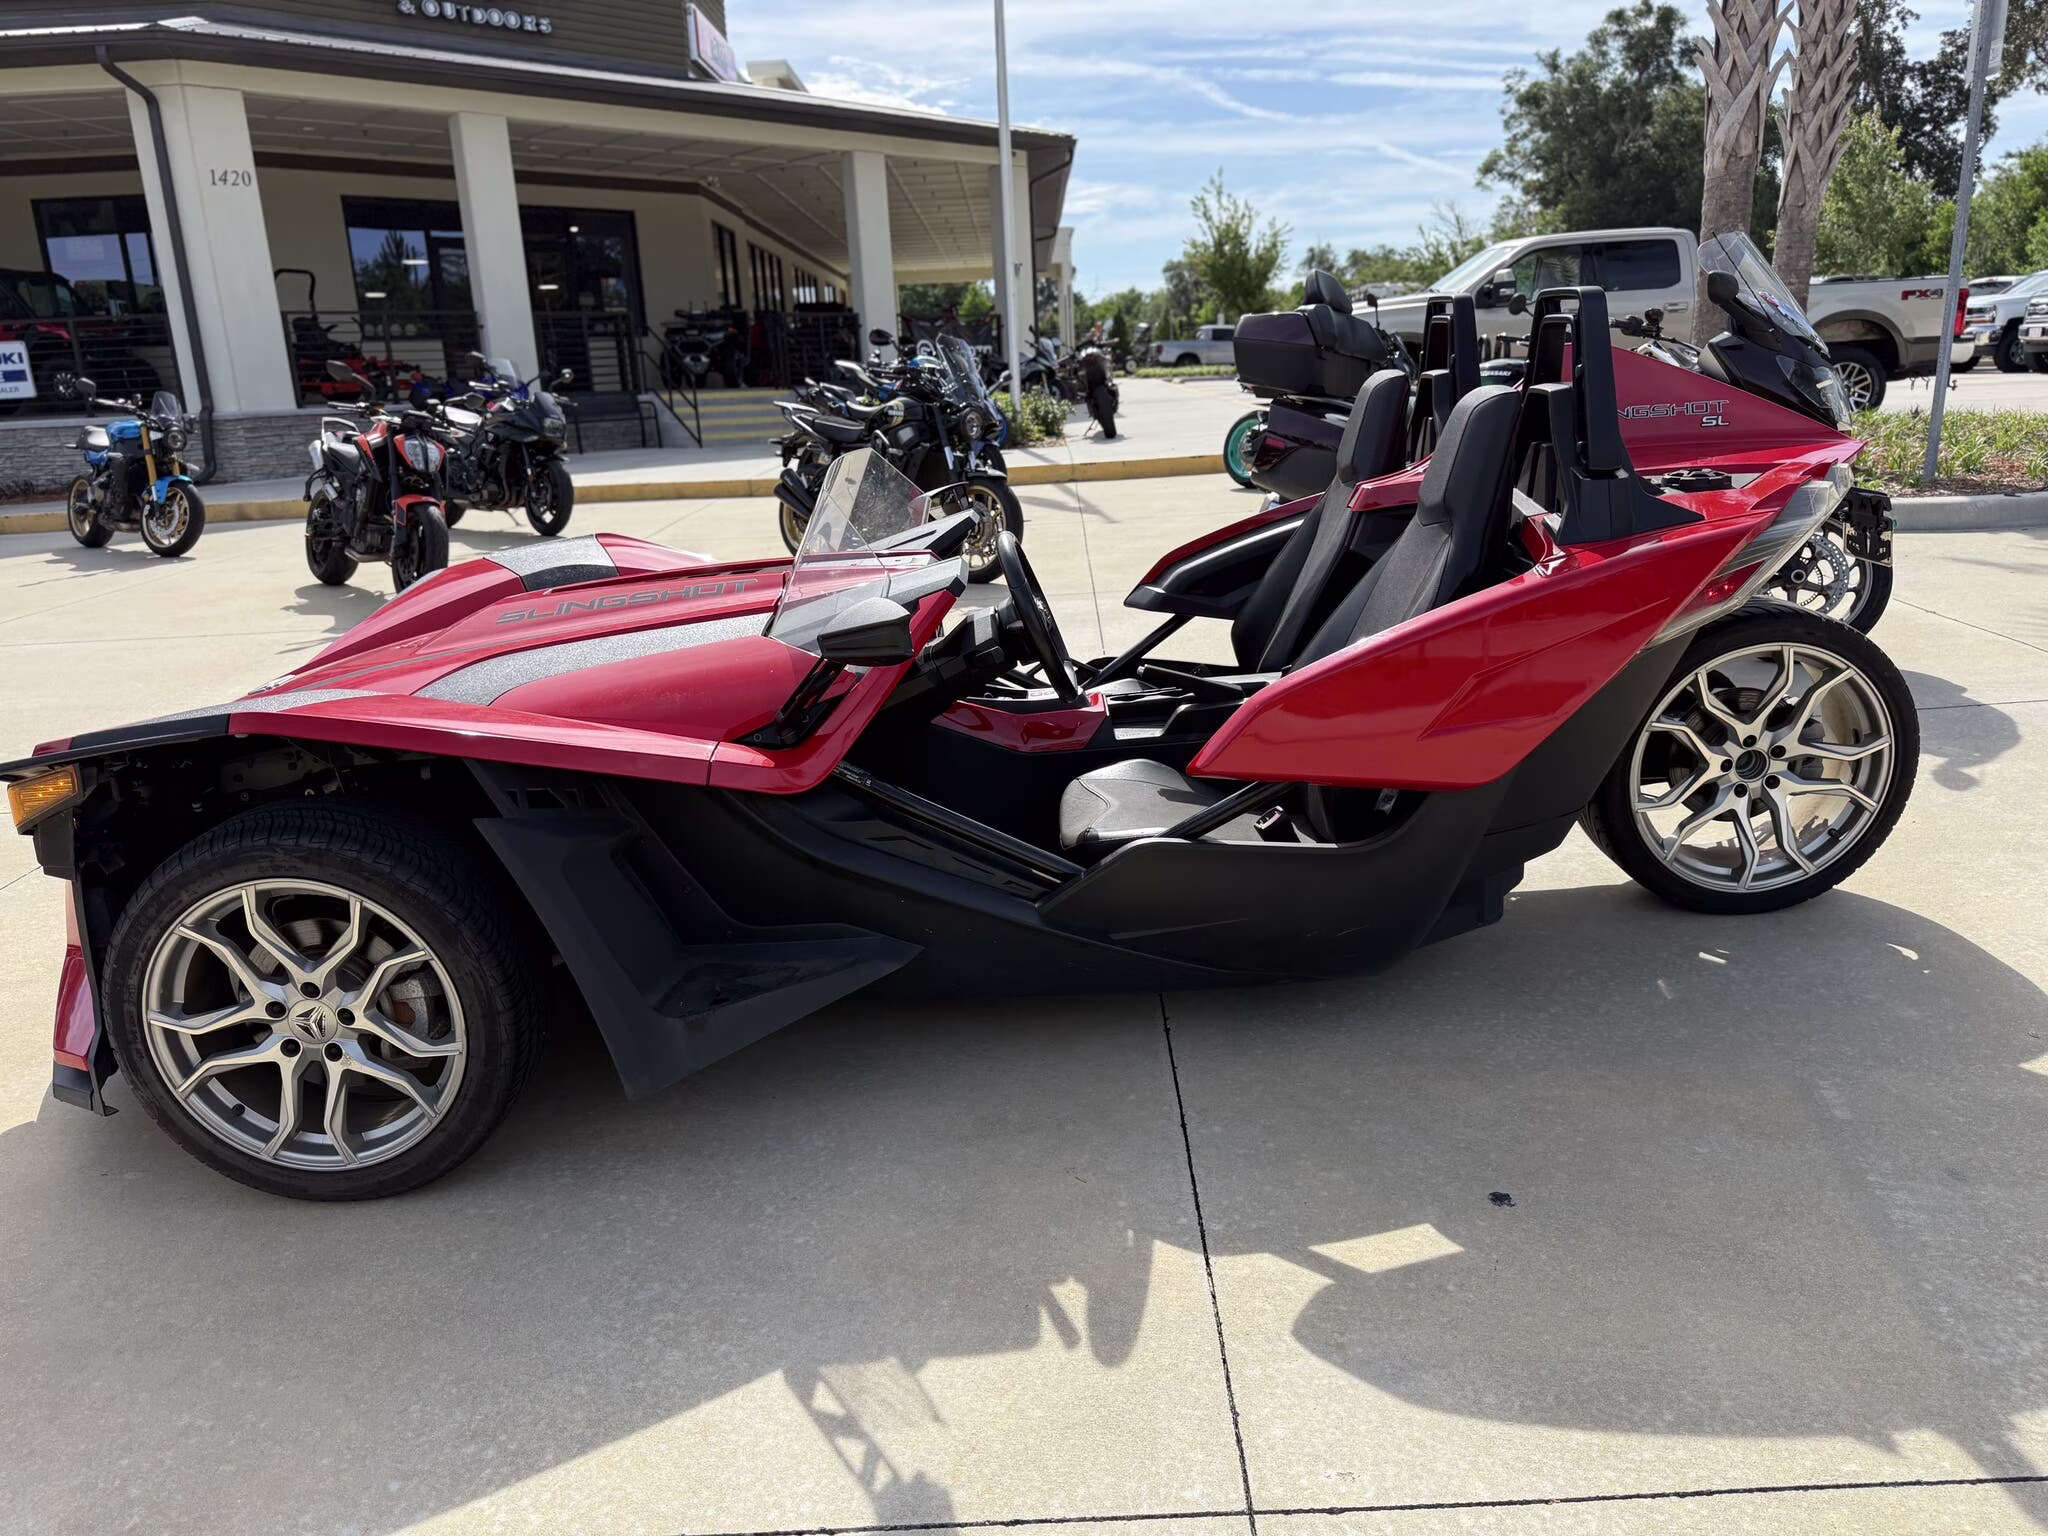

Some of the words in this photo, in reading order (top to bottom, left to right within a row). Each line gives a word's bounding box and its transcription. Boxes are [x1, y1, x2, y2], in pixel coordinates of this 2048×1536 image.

[398, 0, 416, 15] &
[421, 0, 552, 34] OUTDOORS
[210, 168, 252, 187] 1420
[1901, 288, 1943, 301] FX4
[0, 351, 25, 365] KI
[1617, 399, 1730, 420] NGSHOT
[1701, 415, 1730, 427] SL
[495, 578, 759, 626] SLINGSHOT
